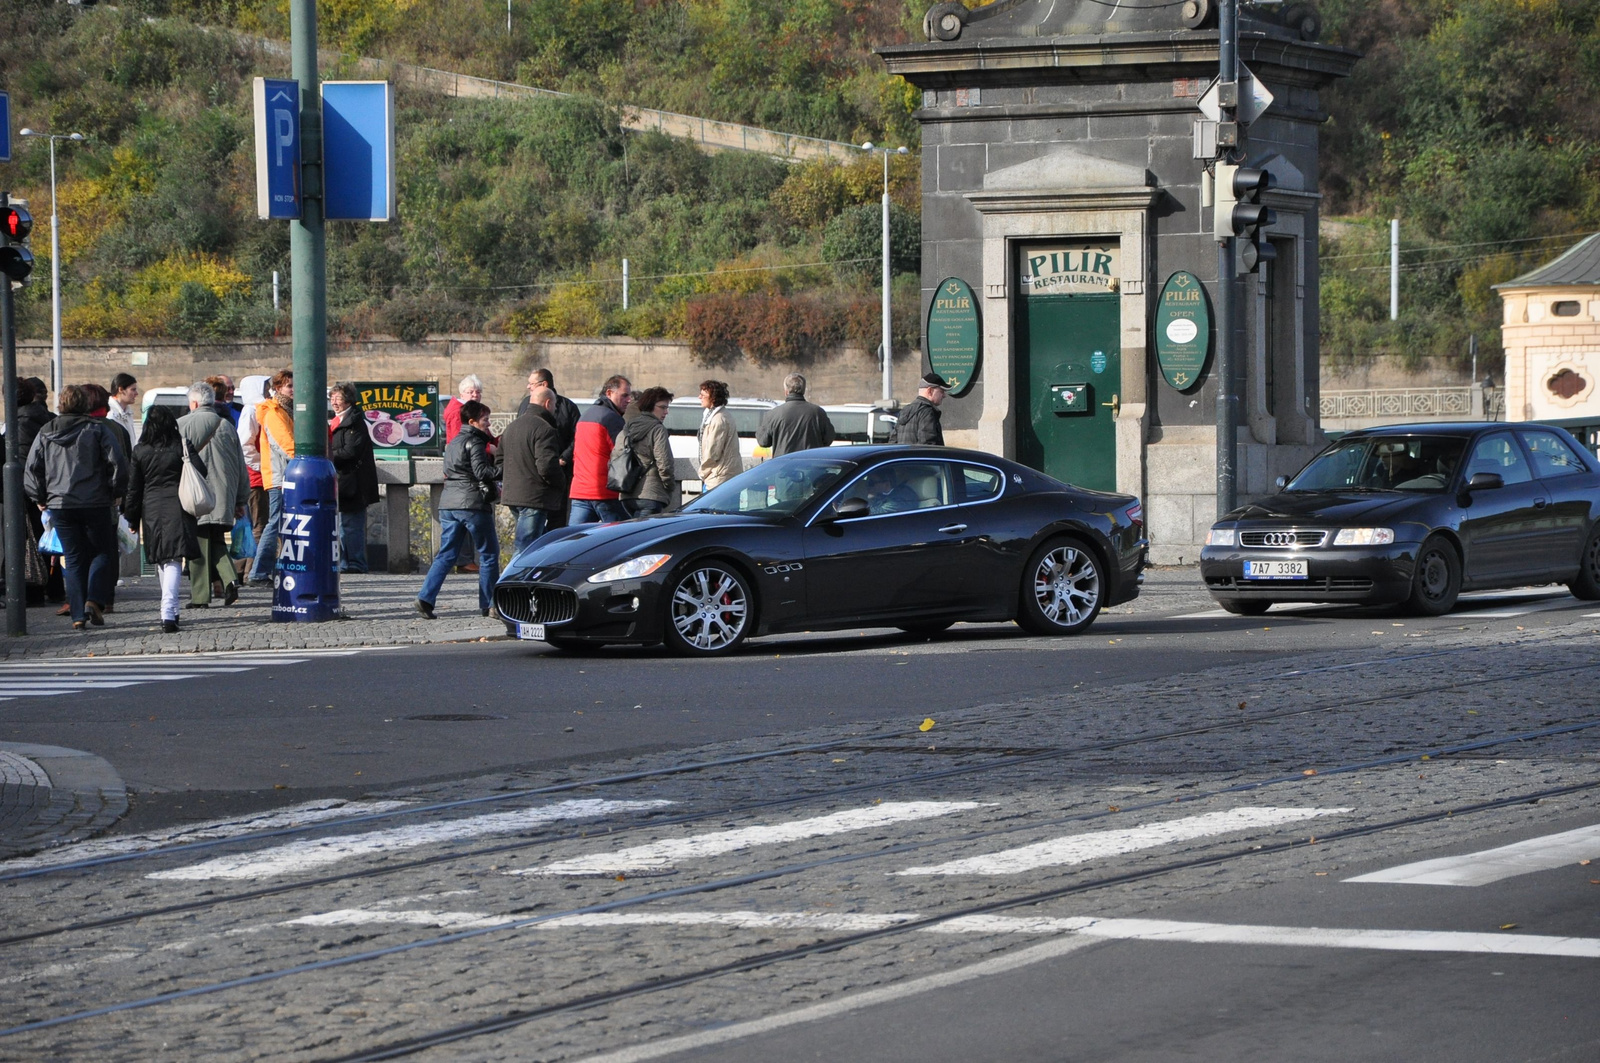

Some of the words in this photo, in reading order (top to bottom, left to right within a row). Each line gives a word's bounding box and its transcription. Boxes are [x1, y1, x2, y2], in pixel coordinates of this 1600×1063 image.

[274, 109, 294, 167] P
[1029, 245, 1113, 278] PILÍŘ
[1034, 274, 1109, 289] RESTAURANT
[1165, 288, 1200, 301] PILÍŘ
[936, 297, 970, 309] PILÍŘ
[360, 385, 415, 405] PILÍŘ
[362, 401, 414, 411] RESTAURANT
[286, 563, 306, 571] LOOK
[1252, 563, 1270, 574] 7A7
[1278, 563, 1302, 574] 3382
[530, 627, 543, 638] 2222
